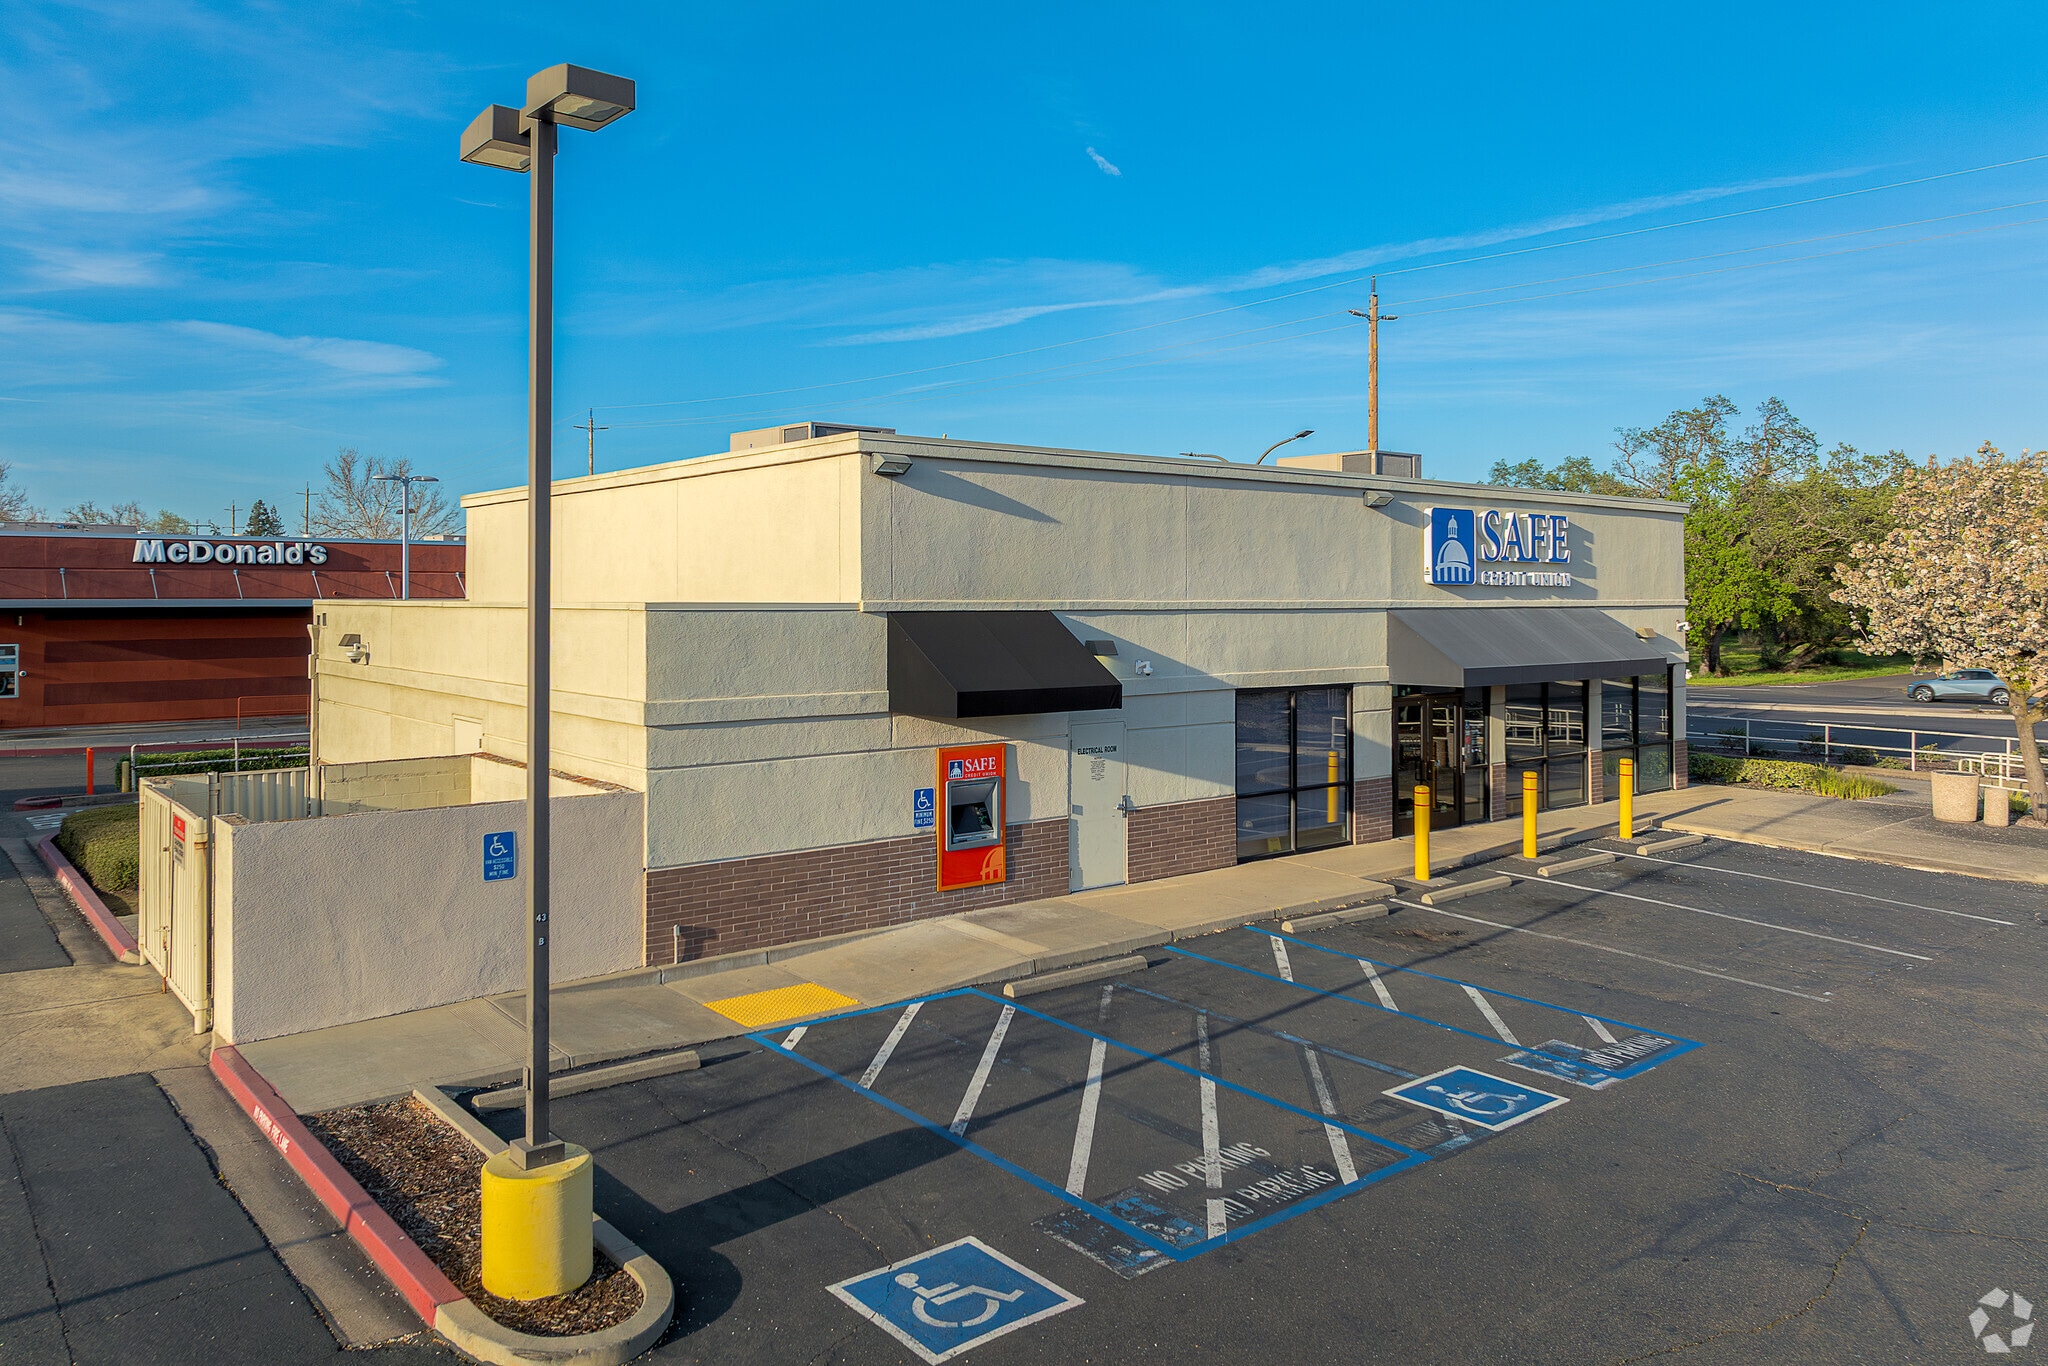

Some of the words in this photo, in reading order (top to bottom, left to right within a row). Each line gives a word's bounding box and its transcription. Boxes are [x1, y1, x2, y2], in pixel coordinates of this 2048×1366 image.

[1480, 509, 1571, 564] SAFE
[132, 539, 328, 565] McDonald's
[1481, 570, 1527, 586] CREDIT
[1528, 572, 1571, 586] UNION
[1077, 746, 1104, 755] ELECTRICAL
[1104, 745, 1118, 753] ROOM
[965, 756, 997, 772] SAFE
[536, 913, 547, 922] 43
[538, 937, 545, 946] B
[1138, 1170, 1189, 1193] NO
